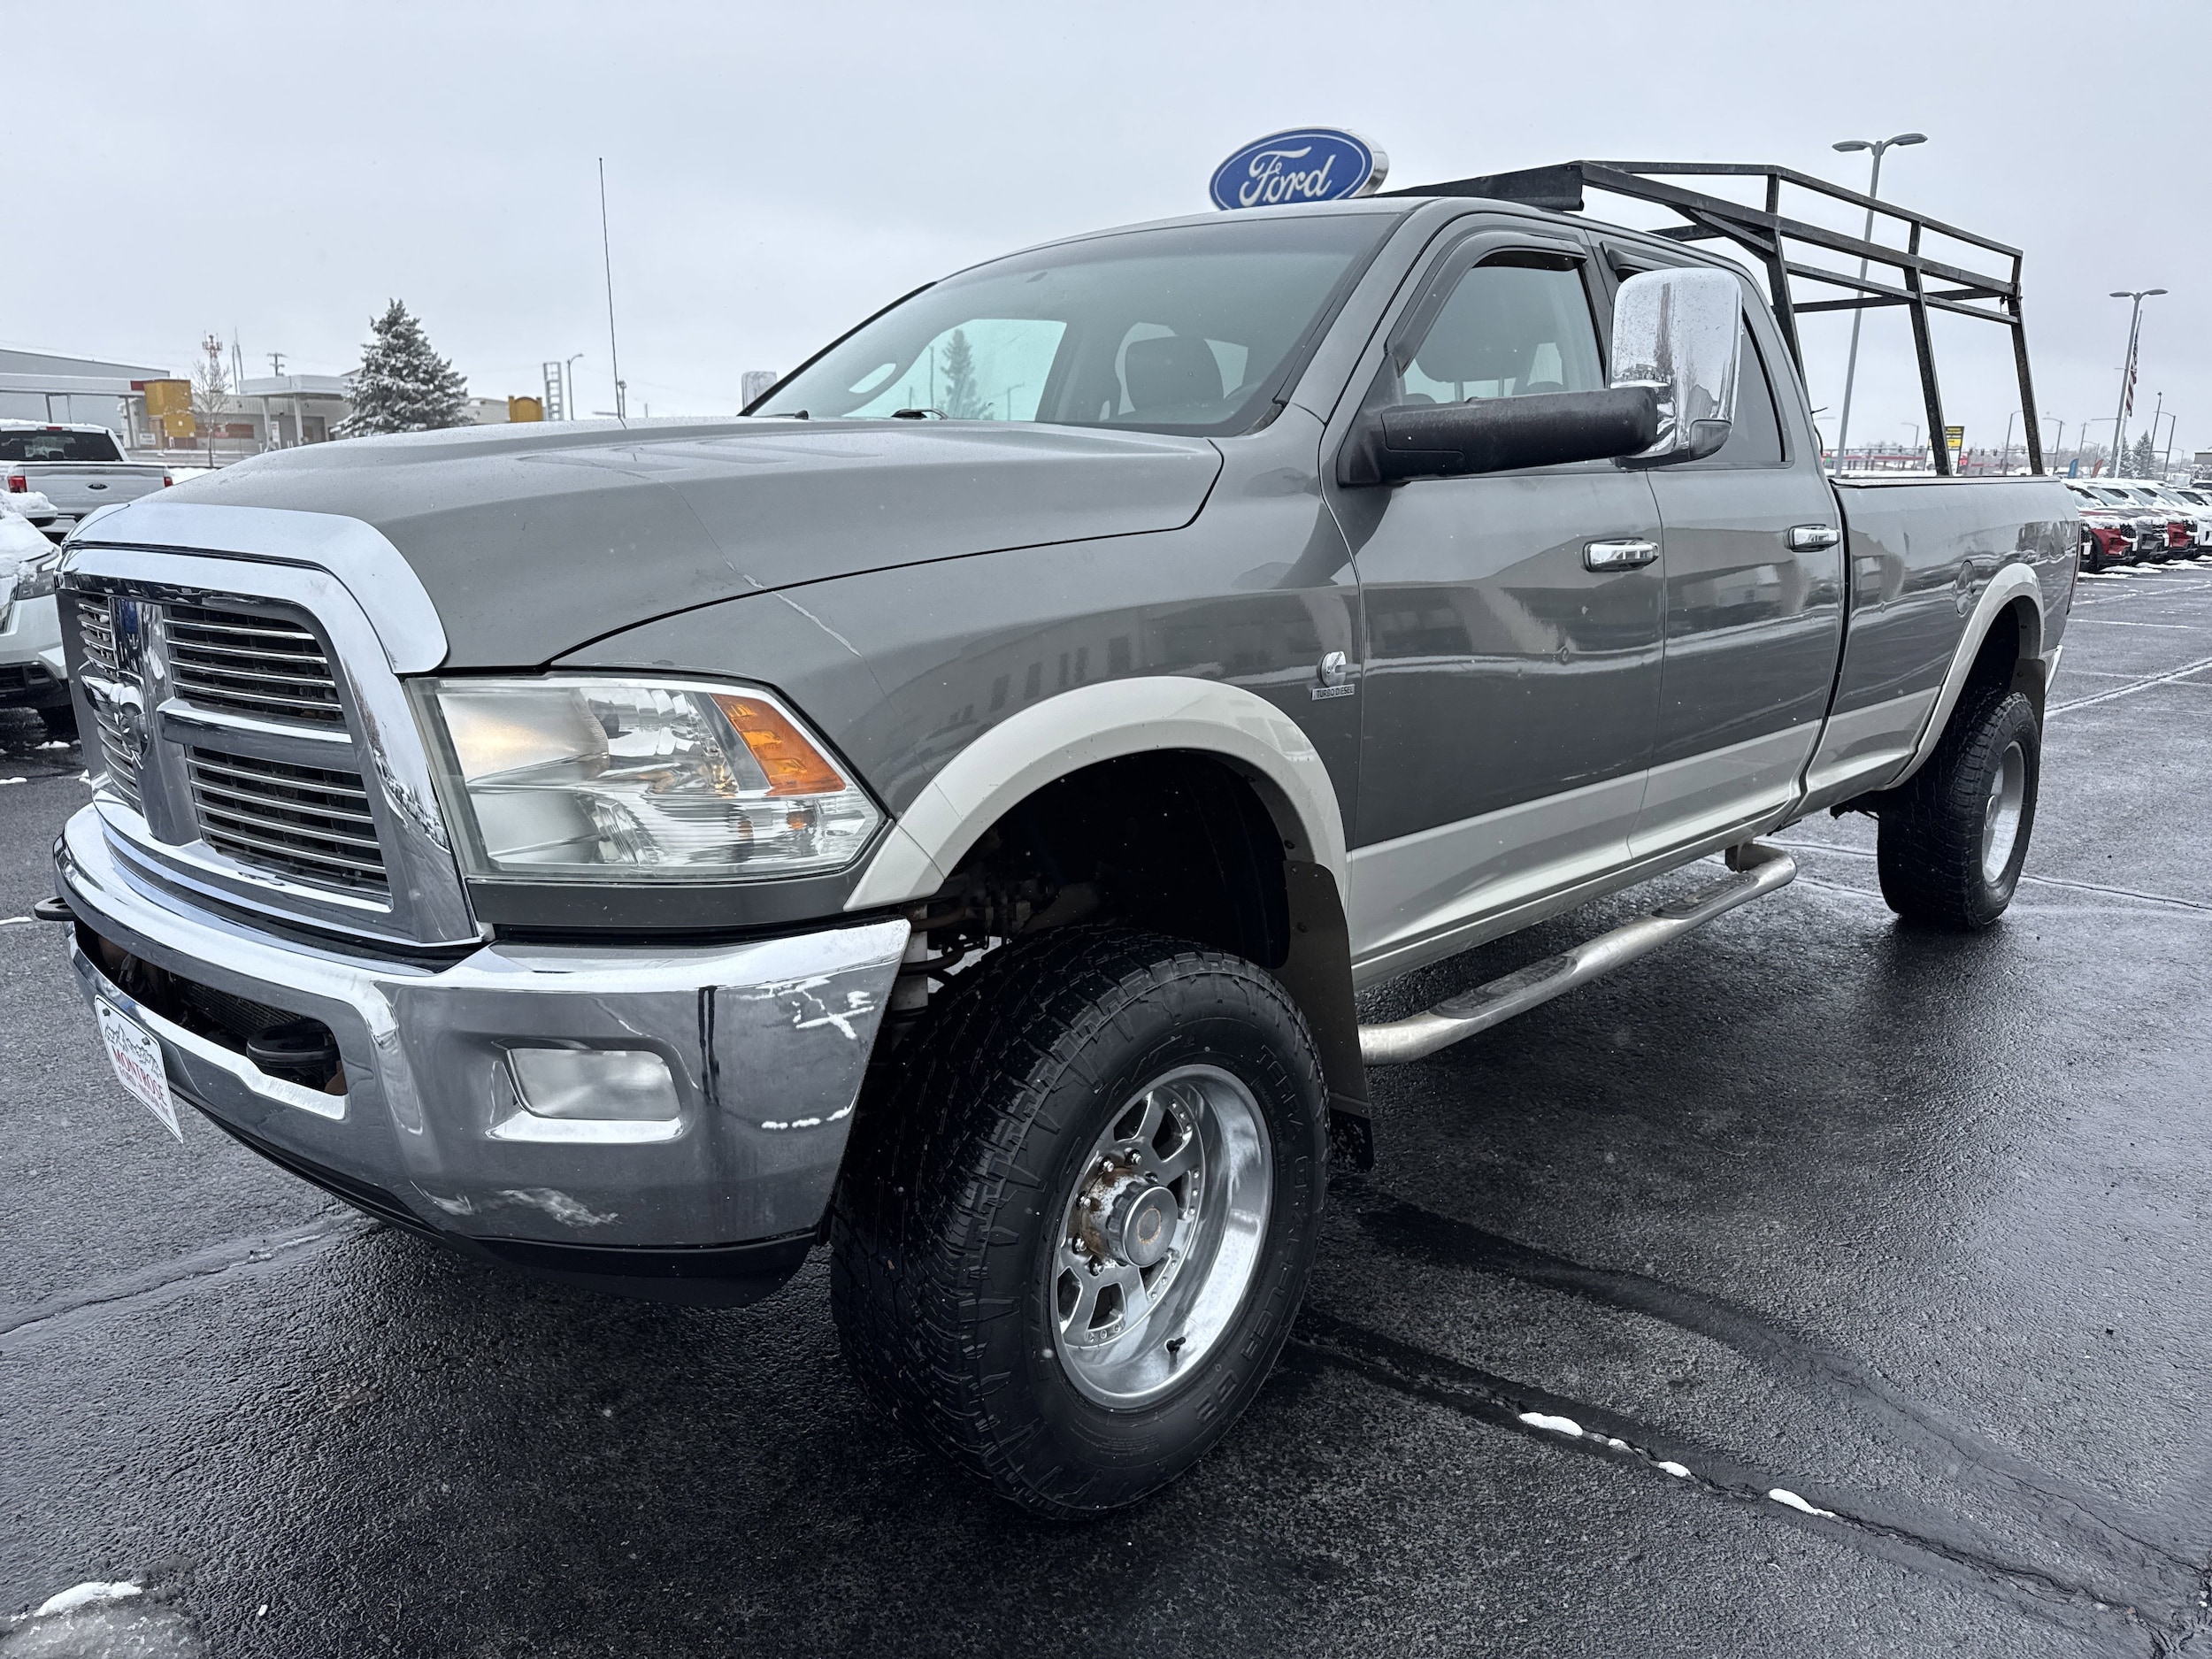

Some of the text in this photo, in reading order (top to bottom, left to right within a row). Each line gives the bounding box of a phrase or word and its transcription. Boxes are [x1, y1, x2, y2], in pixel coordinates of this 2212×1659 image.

[1239, 145, 1336, 208] Ford
[1317, 687, 1354, 698] TURBO DIESEL
[111, 1045, 167, 1106] MONTROSE
